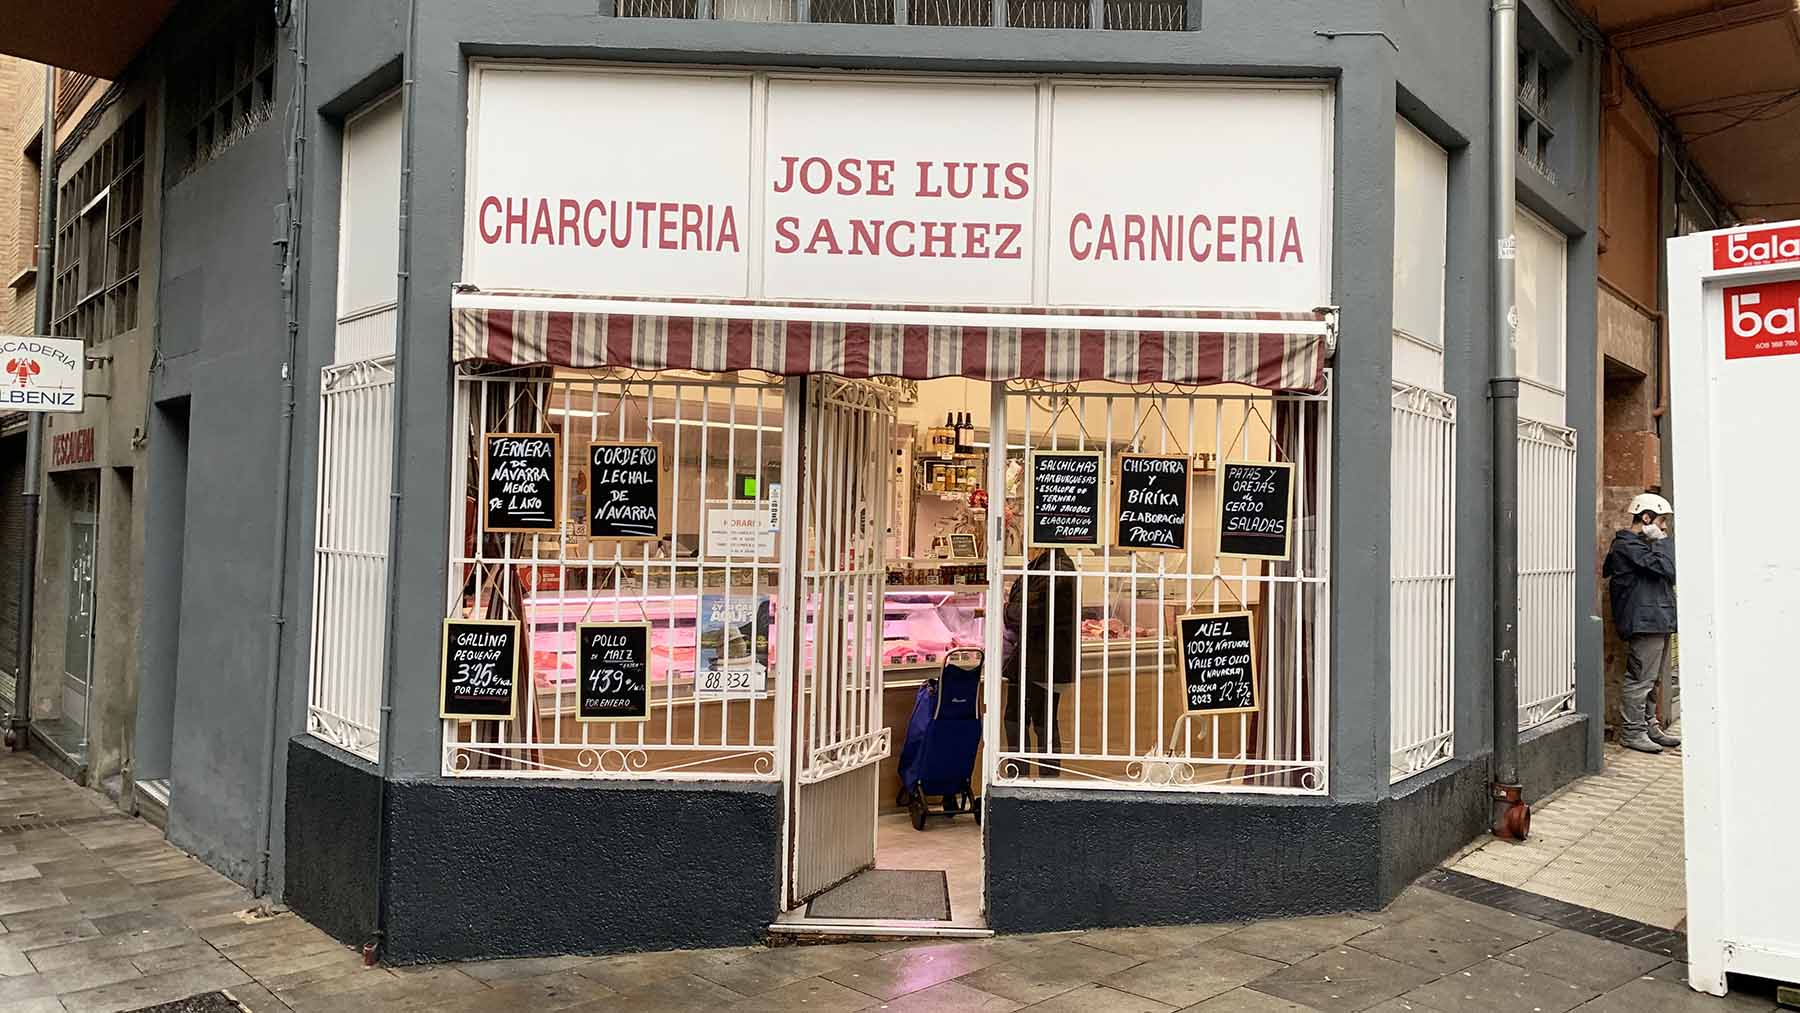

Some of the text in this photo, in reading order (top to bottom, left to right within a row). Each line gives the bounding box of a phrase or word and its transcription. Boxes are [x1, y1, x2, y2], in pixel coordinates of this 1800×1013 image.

[773, 156, 1029, 200] JOSE LUIS
[479, 195, 740, 253] CHARCUTERIA
[775, 216, 1022, 259] SANCHEZ
[1069, 212, 1304, 263] CARNICERIA
[492, 438, 552, 459] TERNERA
[594, 447, 656, 466] CORDERO
[491, 461, 550, 481] NAVARRA
[510, 460, 527, 468] DE
[1040, 458, 1097, 473] SALCHICHAS
[1123, 459, 1185, 474] CHISTORRA
[601, 469, 653, 484] LECHAL
[1148, 475, 1157, 487] Y
[1228, 468, 1277, 482] PATAS Y
[502, 481, 538, 493] MENOR
[1039, 484, 1076, 494] ESCALOPE
[1232, 480, 1275, 493] OREJAS
[610, 490, 629, 501] DE
[489, 497, 503, 511] DE
[520, 497, 542, 510] AÑO
[595, 501, 656, 520] NAVARRA
[1040, 503, 1091, 513] SAN JACOBOS
[1225, 501, 1263, 512] CERDO
[1055, 526, 1088, 536] PROPIA
[1227, 517, 1285, 533] SALADAS
[1194, 621, 1232, 637] MIEL
[457, 632, 507, 647] GALLINA
[592, 634, 627, 647] POLLO
[1187, 639, 1250, 655] 100% NATURAL
[454, 649, 502, 661] PEQUEÑA
[603, 649, 633, 660] MAIZ
[1188, 654, 1250, 670] VALLE DE OLLO
[454, 685, 508, 696] POR ENTERA
[600, 698, 630, 708] ENTERO
[1191, 694, 1212, 705] 2023
